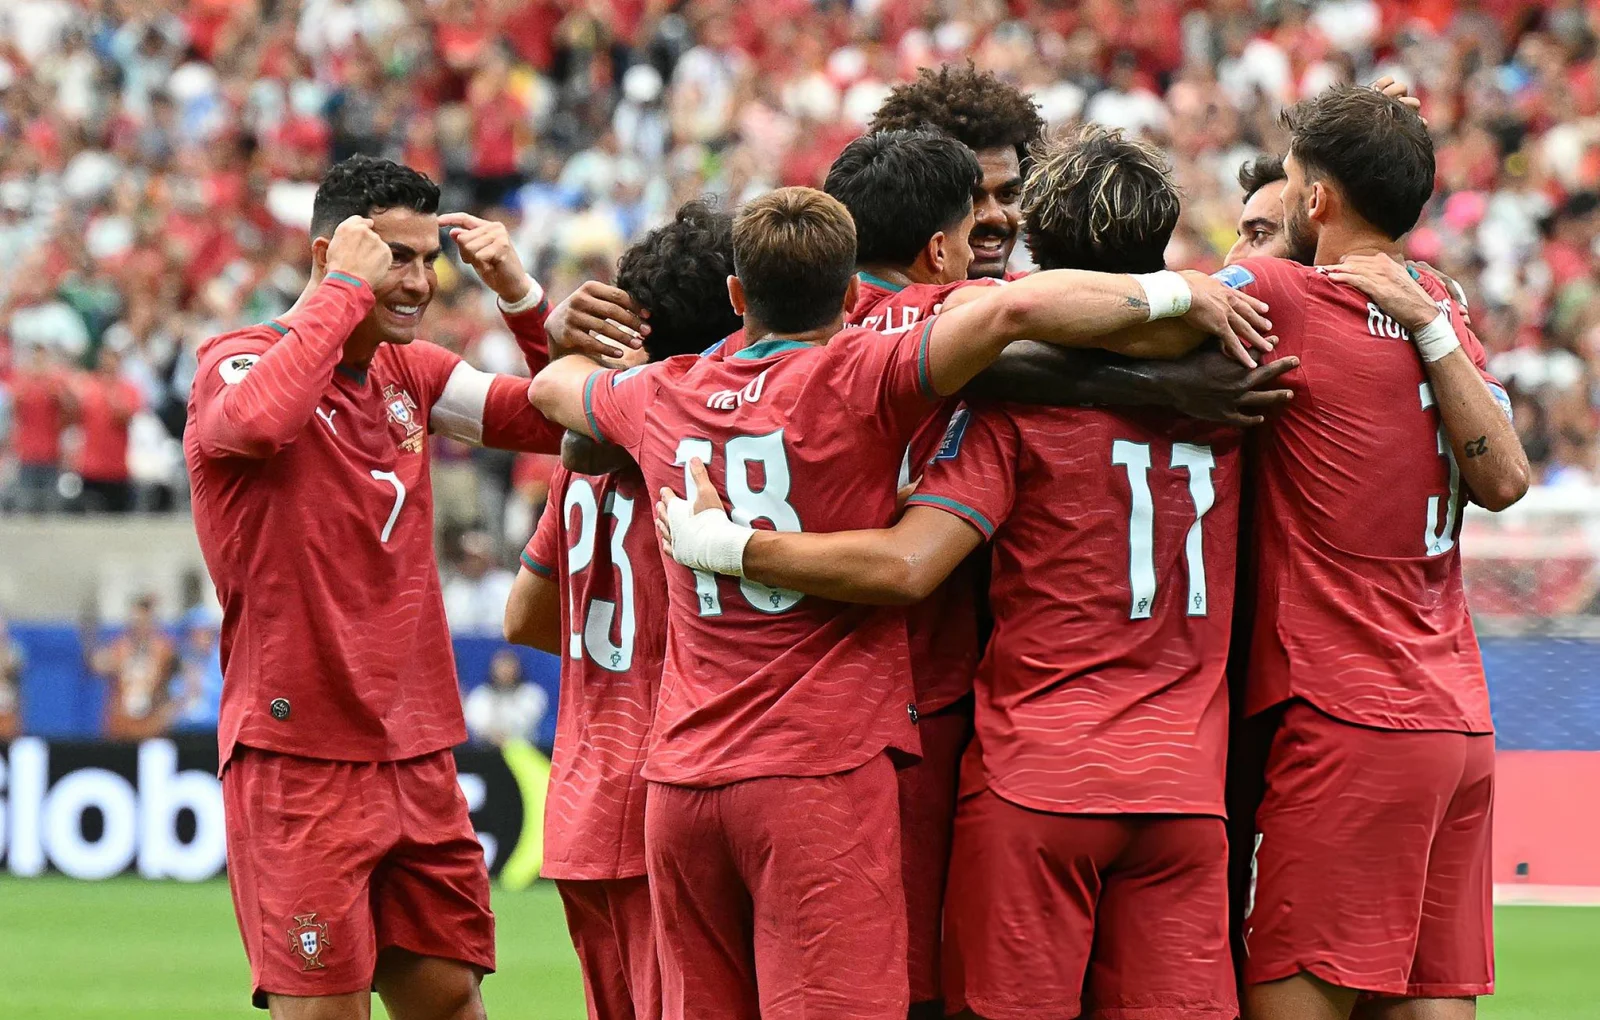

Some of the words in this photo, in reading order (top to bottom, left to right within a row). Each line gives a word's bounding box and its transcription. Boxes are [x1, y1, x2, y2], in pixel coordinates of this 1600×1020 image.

[370, 469, 406, 543] 7
[563, 478, 637, 673] 23
[671, 427, 805, 617] 18
[1111, 437, 1217, 620] 11
